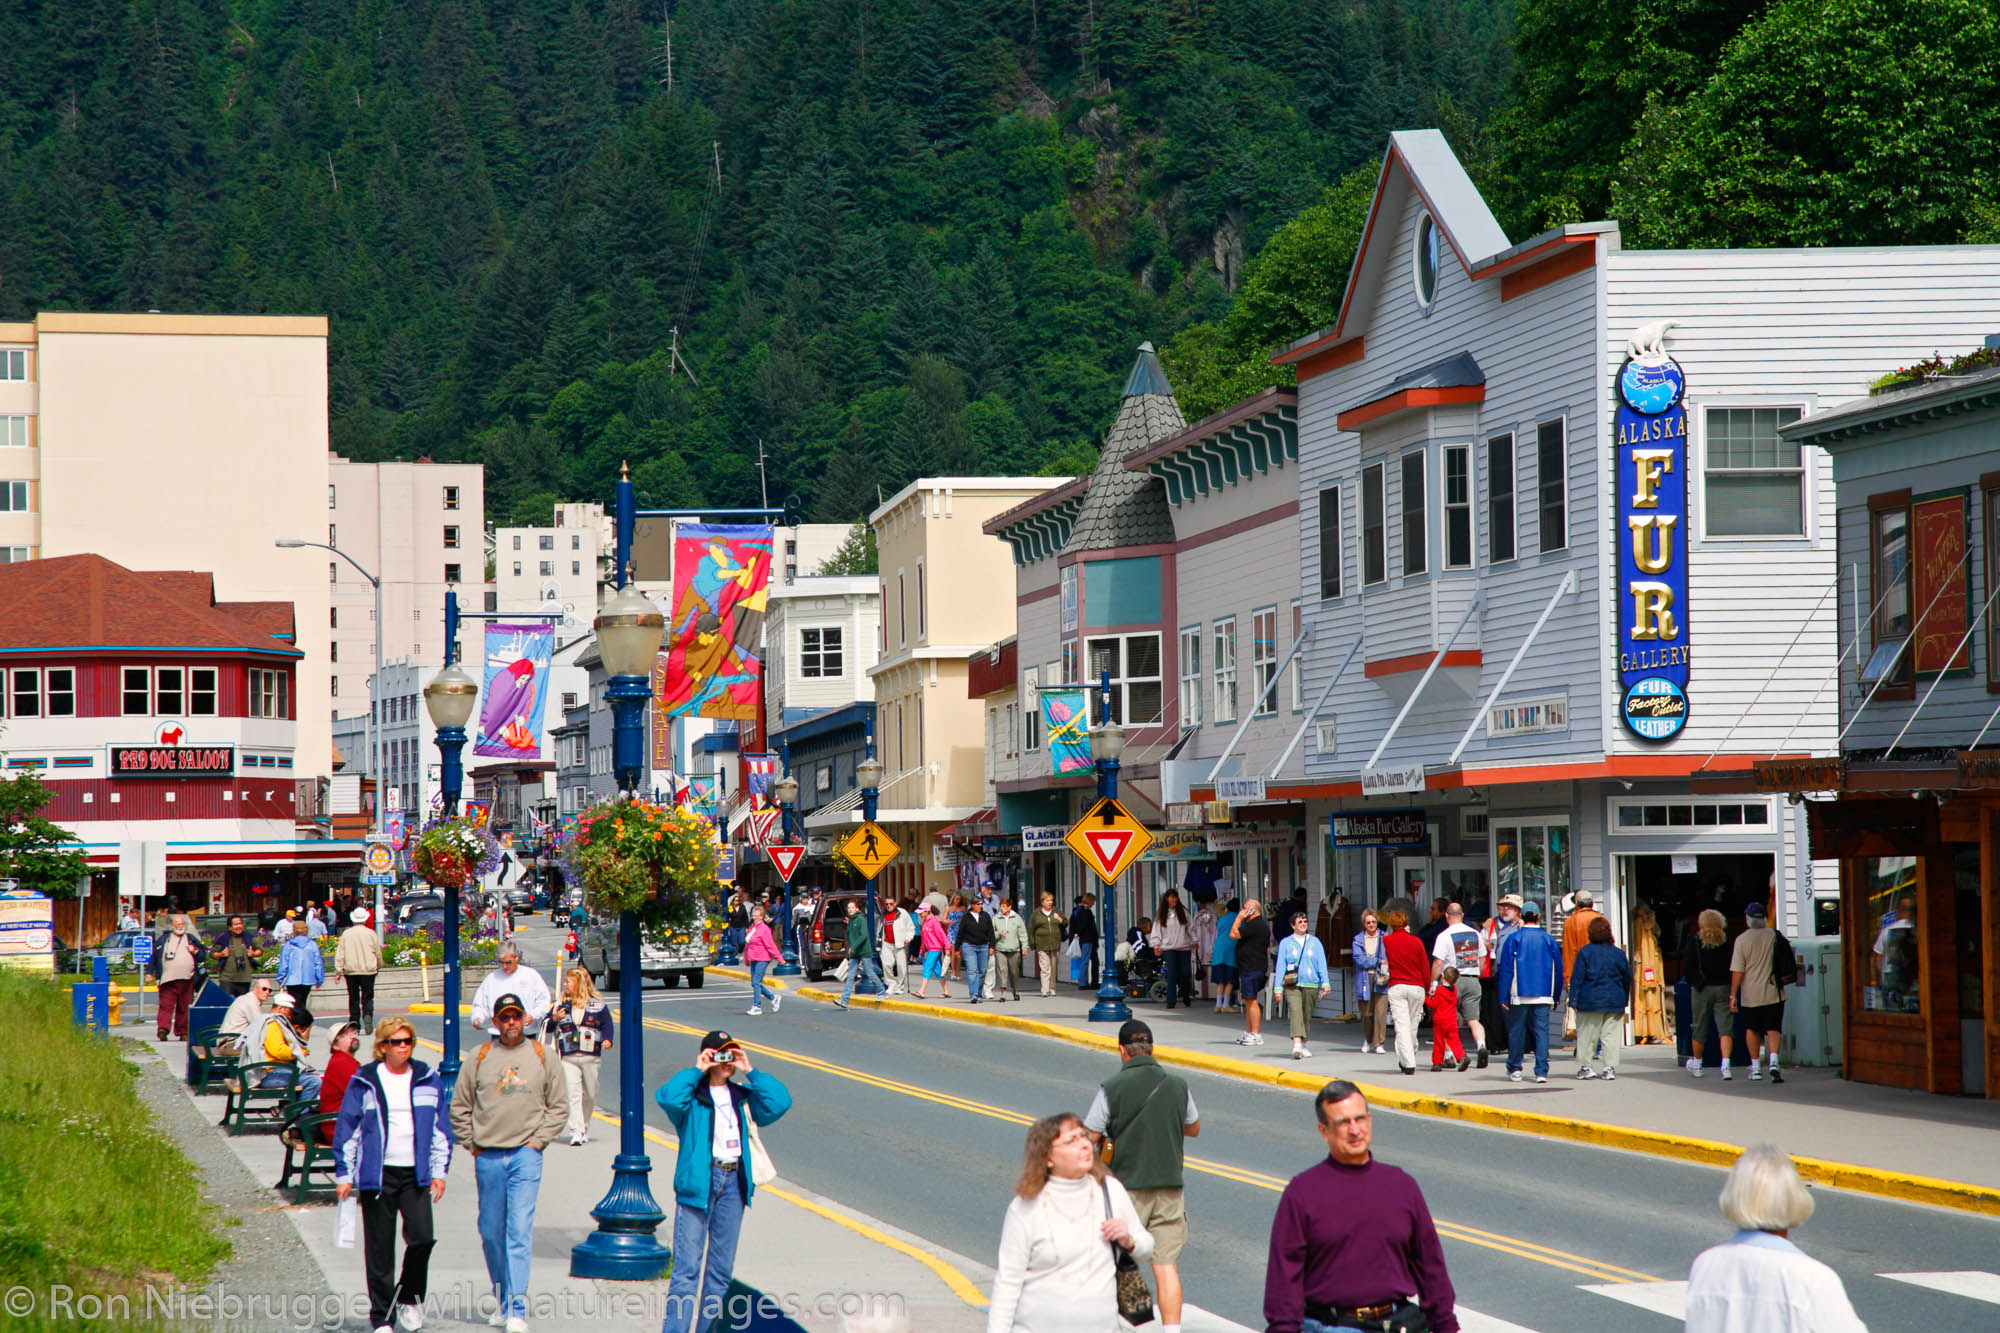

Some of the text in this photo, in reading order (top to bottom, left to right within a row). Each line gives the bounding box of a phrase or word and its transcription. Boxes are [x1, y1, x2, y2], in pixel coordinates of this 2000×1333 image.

[1618, 416, 1686, 446] ALASKA
[1628, 449, 1679, 641] FUR
[1620, 645, 1689, 673] GALLERY
[1638, 680, 1672, 694] FUR
[1627, 696, 1671, 713] Factory
[1651, 701, 1684, 717] Outlet
[1635, 719, 1676, 737] LEATHER
[119, 749, 230, 769] RED DOG SALOON
[1025, 831, 1064, 840] GLACIER
[1348, 816, 1425, 839] Alaska Fur Gallery
[1165, 832, 1180, 847] GIFT
[176, 870, 220, 879] SALOON
[1804, 864, 1813, 900] 359
